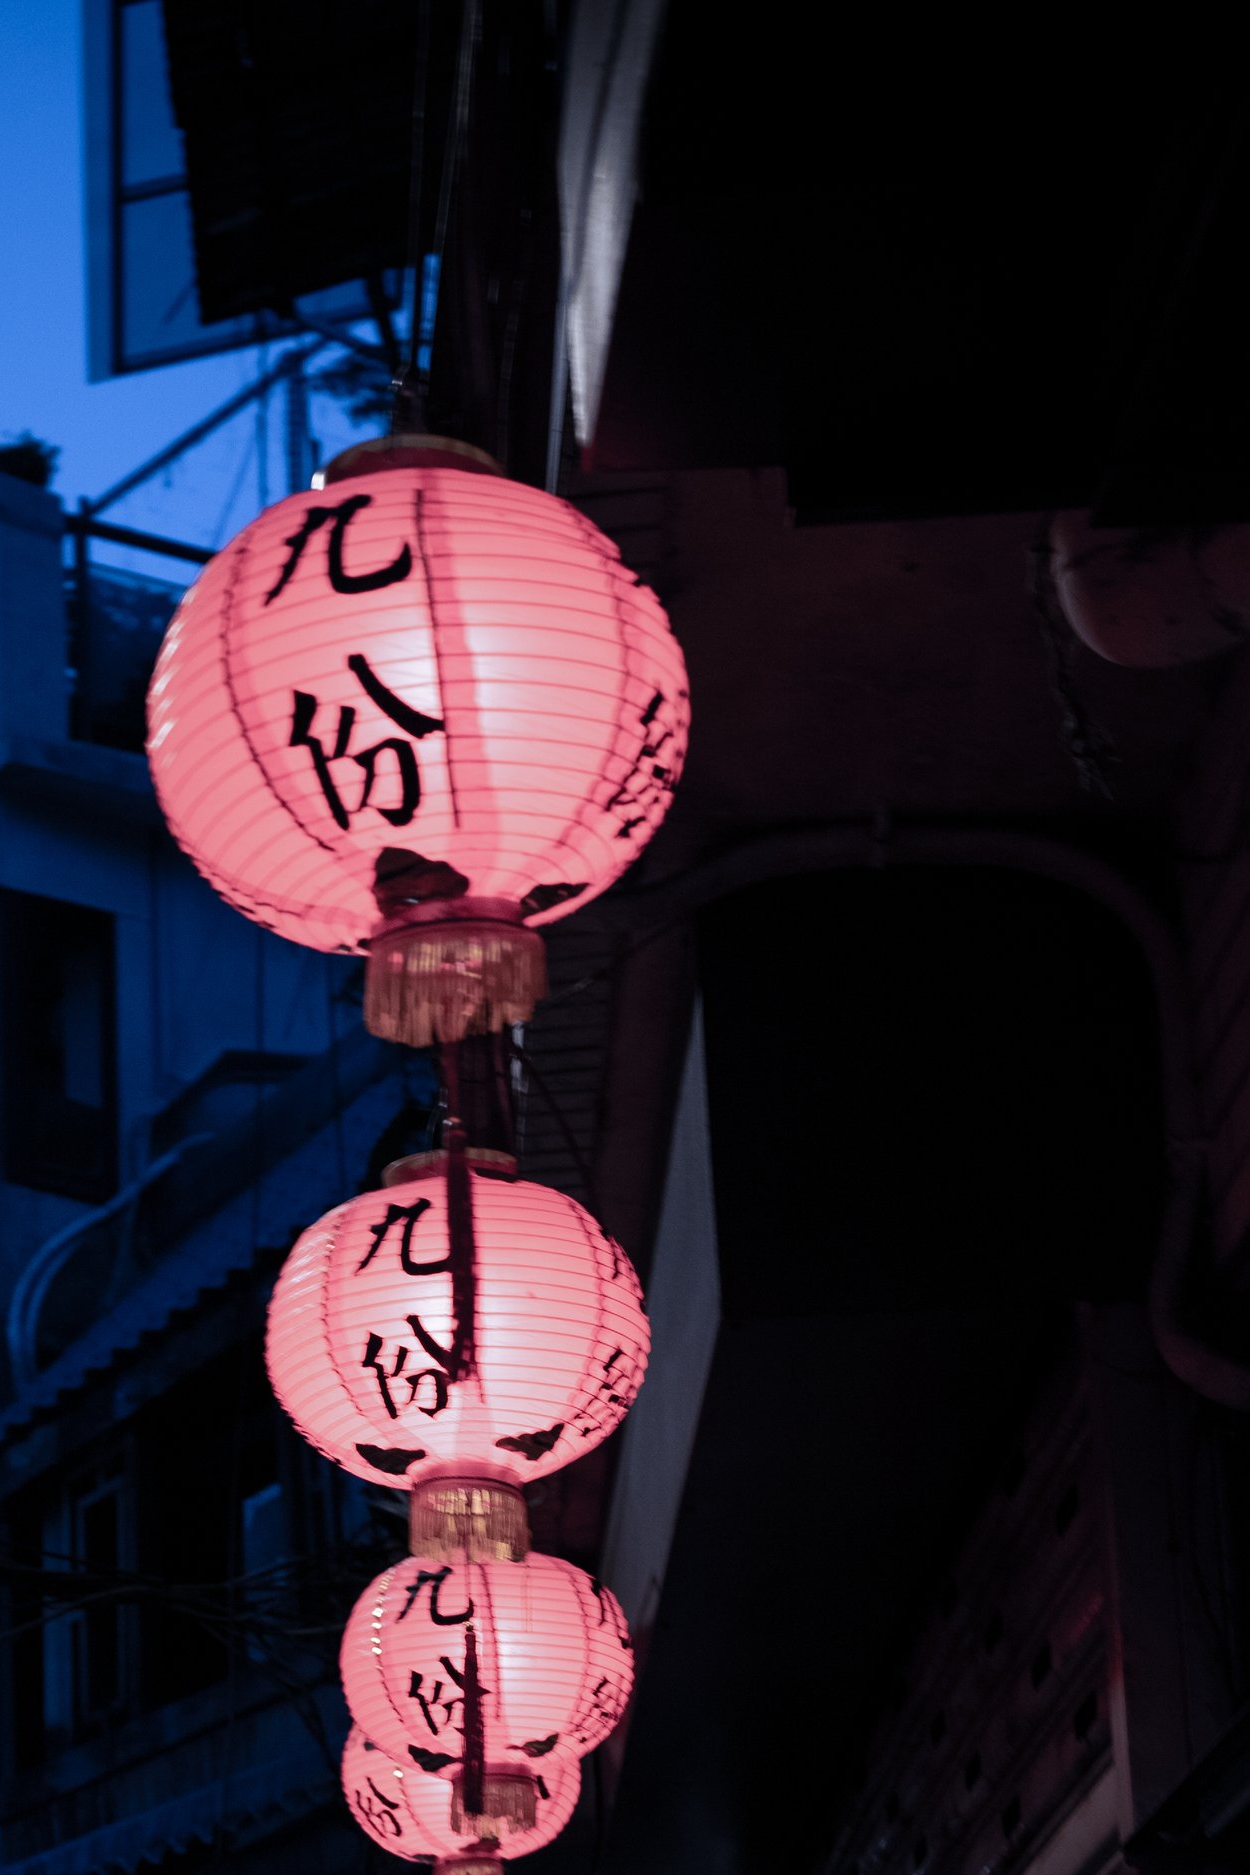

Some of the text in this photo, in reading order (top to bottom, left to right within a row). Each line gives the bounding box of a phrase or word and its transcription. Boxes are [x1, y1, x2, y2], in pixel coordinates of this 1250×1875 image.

[265, 493, 446, 831] 九份
[357, 1197, 456, 1419] 九份
[396, 1566, 489, 1738] 九份
